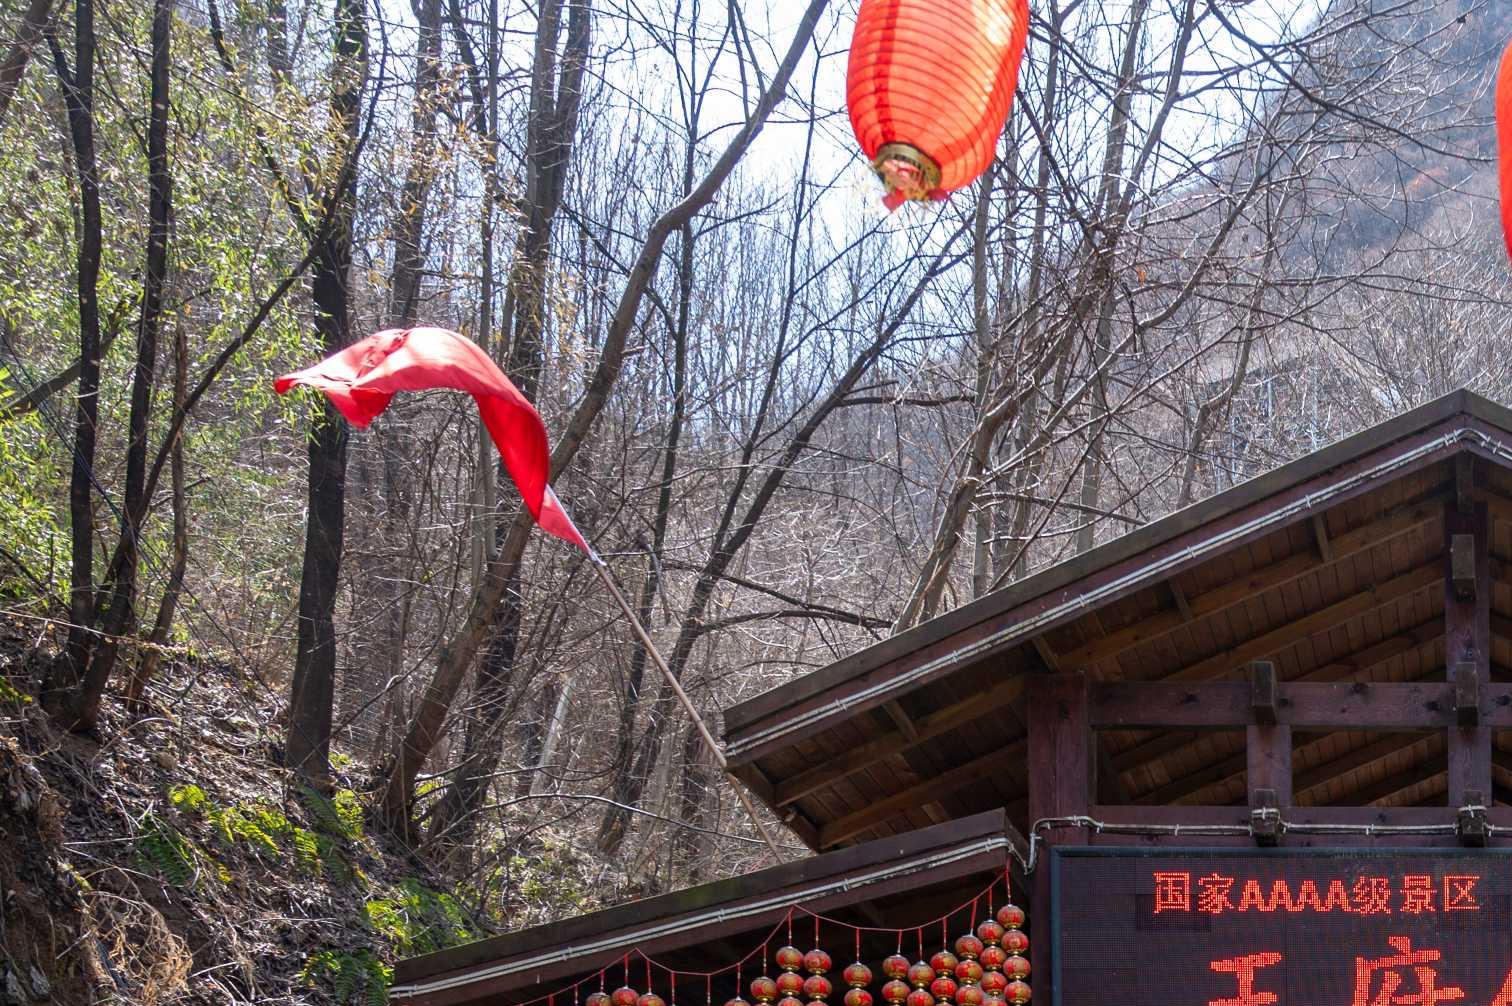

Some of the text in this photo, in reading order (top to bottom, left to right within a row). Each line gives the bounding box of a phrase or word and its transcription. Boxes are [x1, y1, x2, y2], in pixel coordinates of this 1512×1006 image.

[1153, 872, 1481, 915] 国家AAAA级景区
